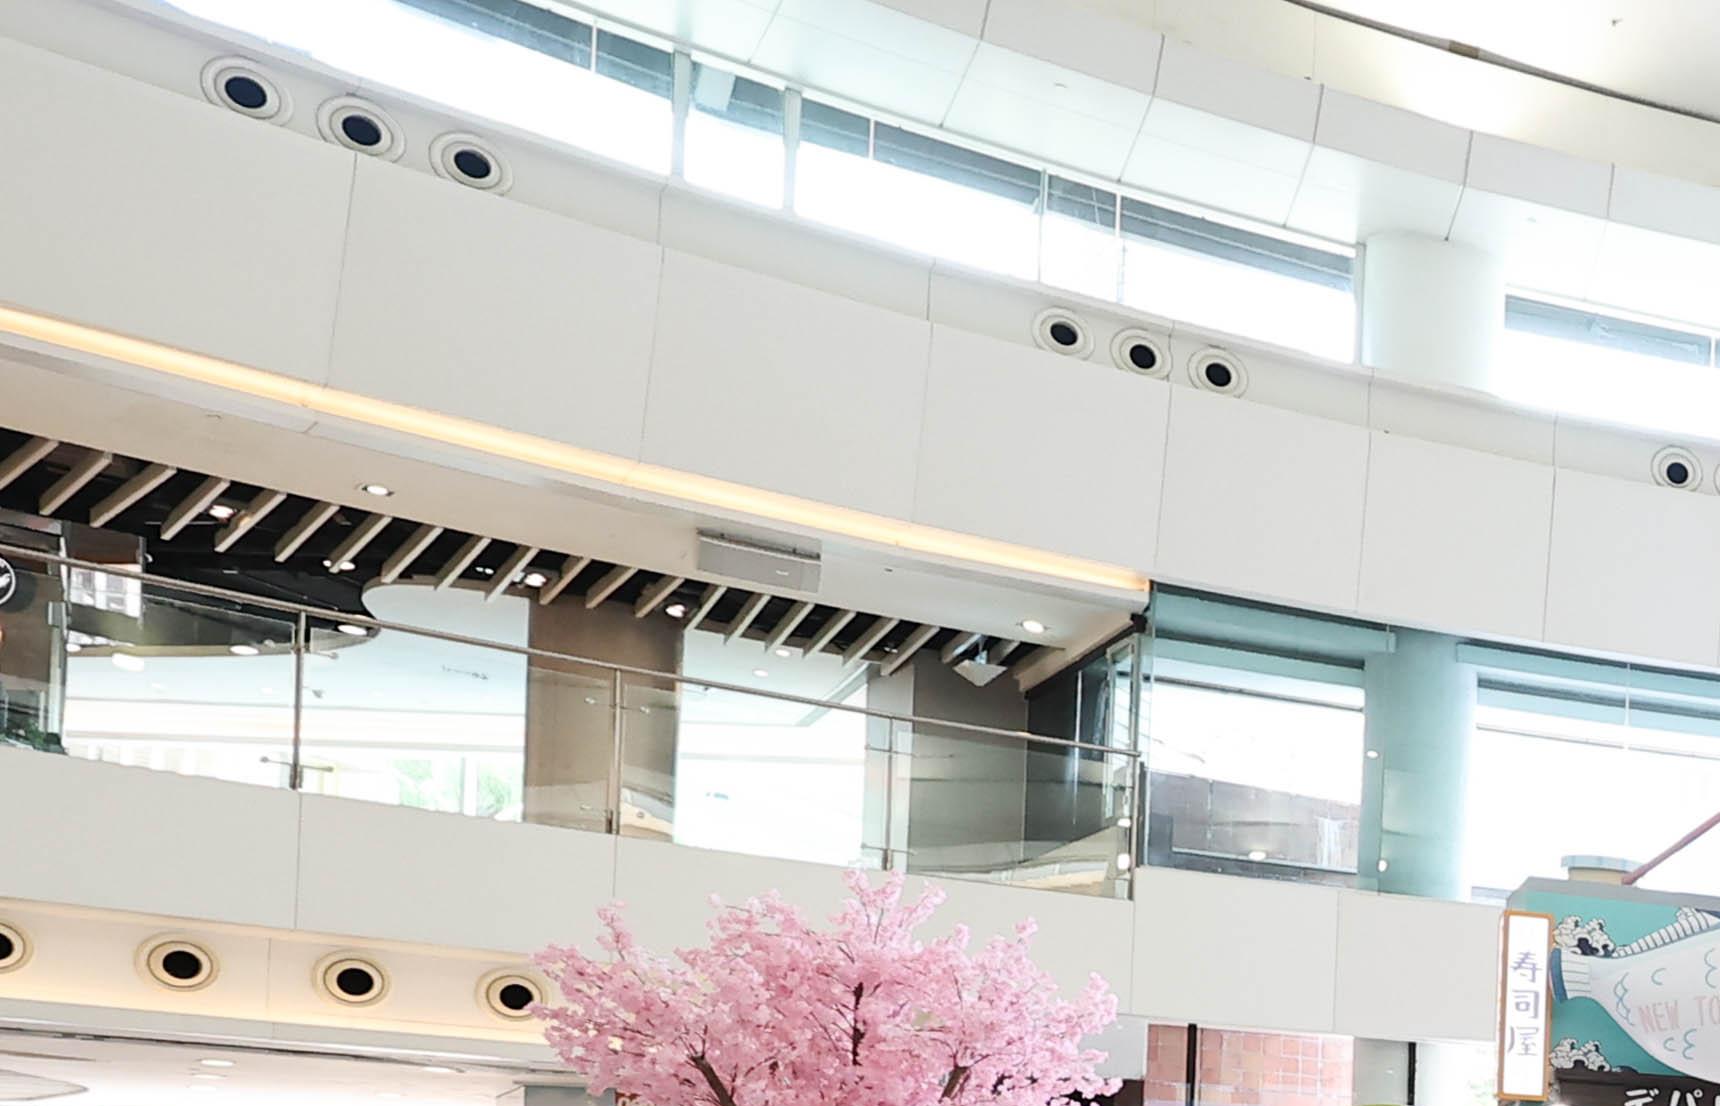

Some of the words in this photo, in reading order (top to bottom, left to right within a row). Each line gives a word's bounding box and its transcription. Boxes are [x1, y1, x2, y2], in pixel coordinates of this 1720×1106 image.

[1507, 950, 1543, 1057] 寿司屋
[1638, 999, 1681, 1033] NEW
